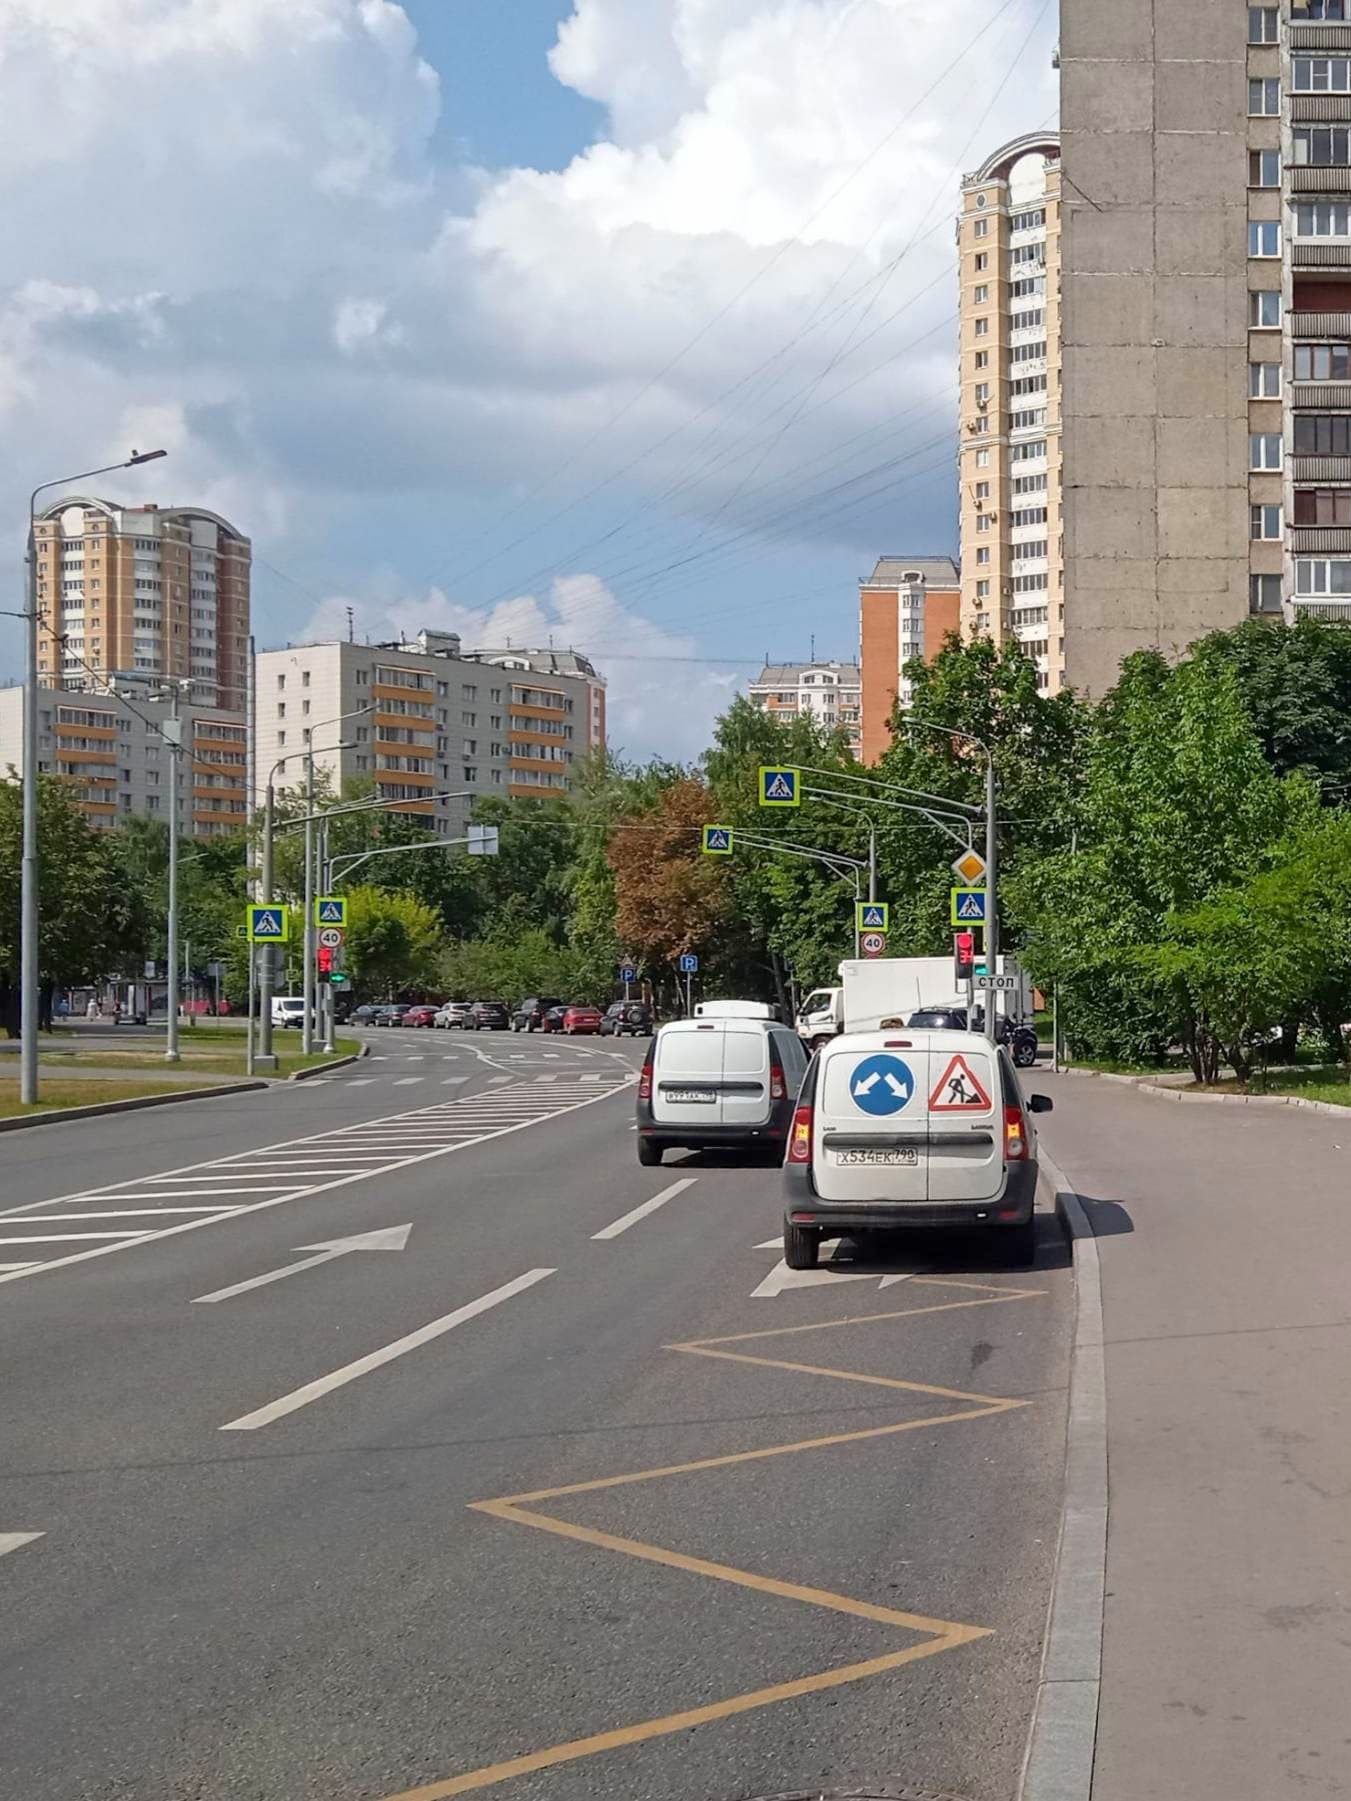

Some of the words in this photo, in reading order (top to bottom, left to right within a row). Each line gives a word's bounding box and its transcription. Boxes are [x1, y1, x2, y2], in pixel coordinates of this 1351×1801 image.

[323, 933, 338, 943] 40
[865, 938, 880, 948] 40
[978, 977, 1015, 988] СТОП
